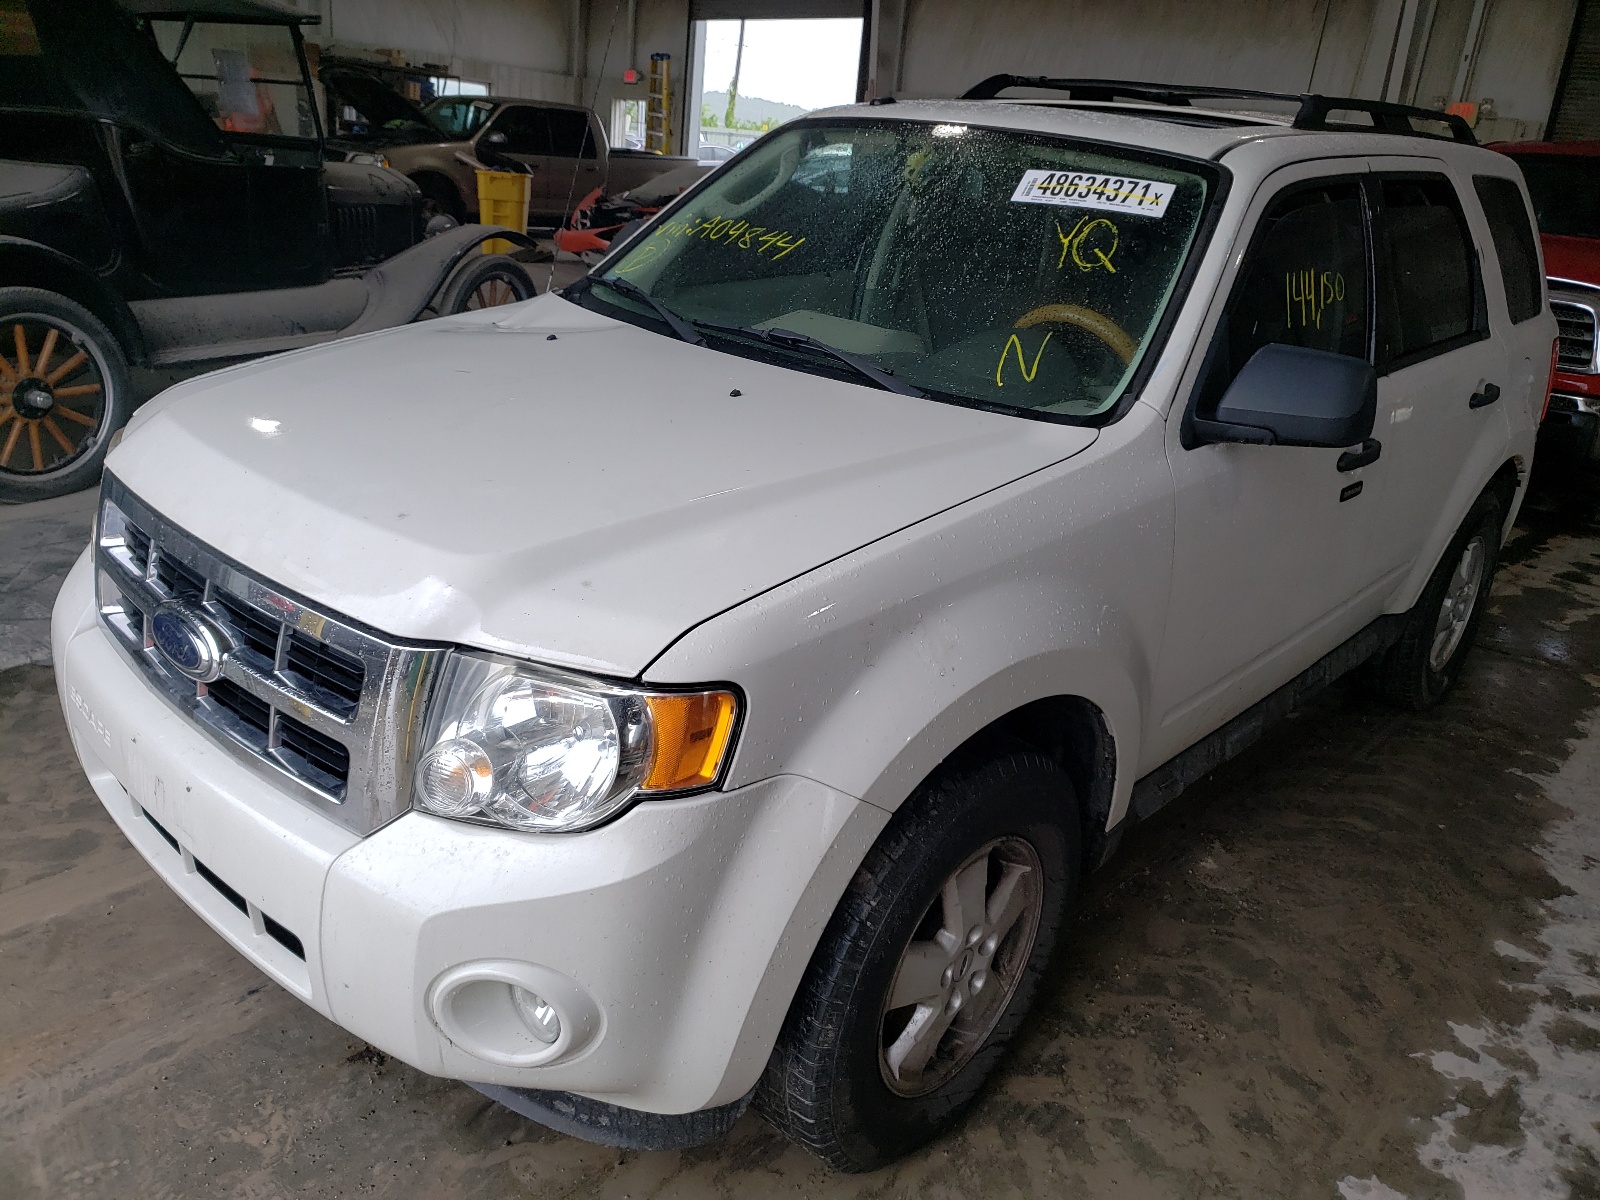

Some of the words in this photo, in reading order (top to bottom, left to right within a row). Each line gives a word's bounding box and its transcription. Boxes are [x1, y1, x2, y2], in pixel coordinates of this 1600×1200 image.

[1037, 173, 1152, 206] 48634371
[1055, 215, 1119, 274] YQ
[996, 331, 1053, 387] N
